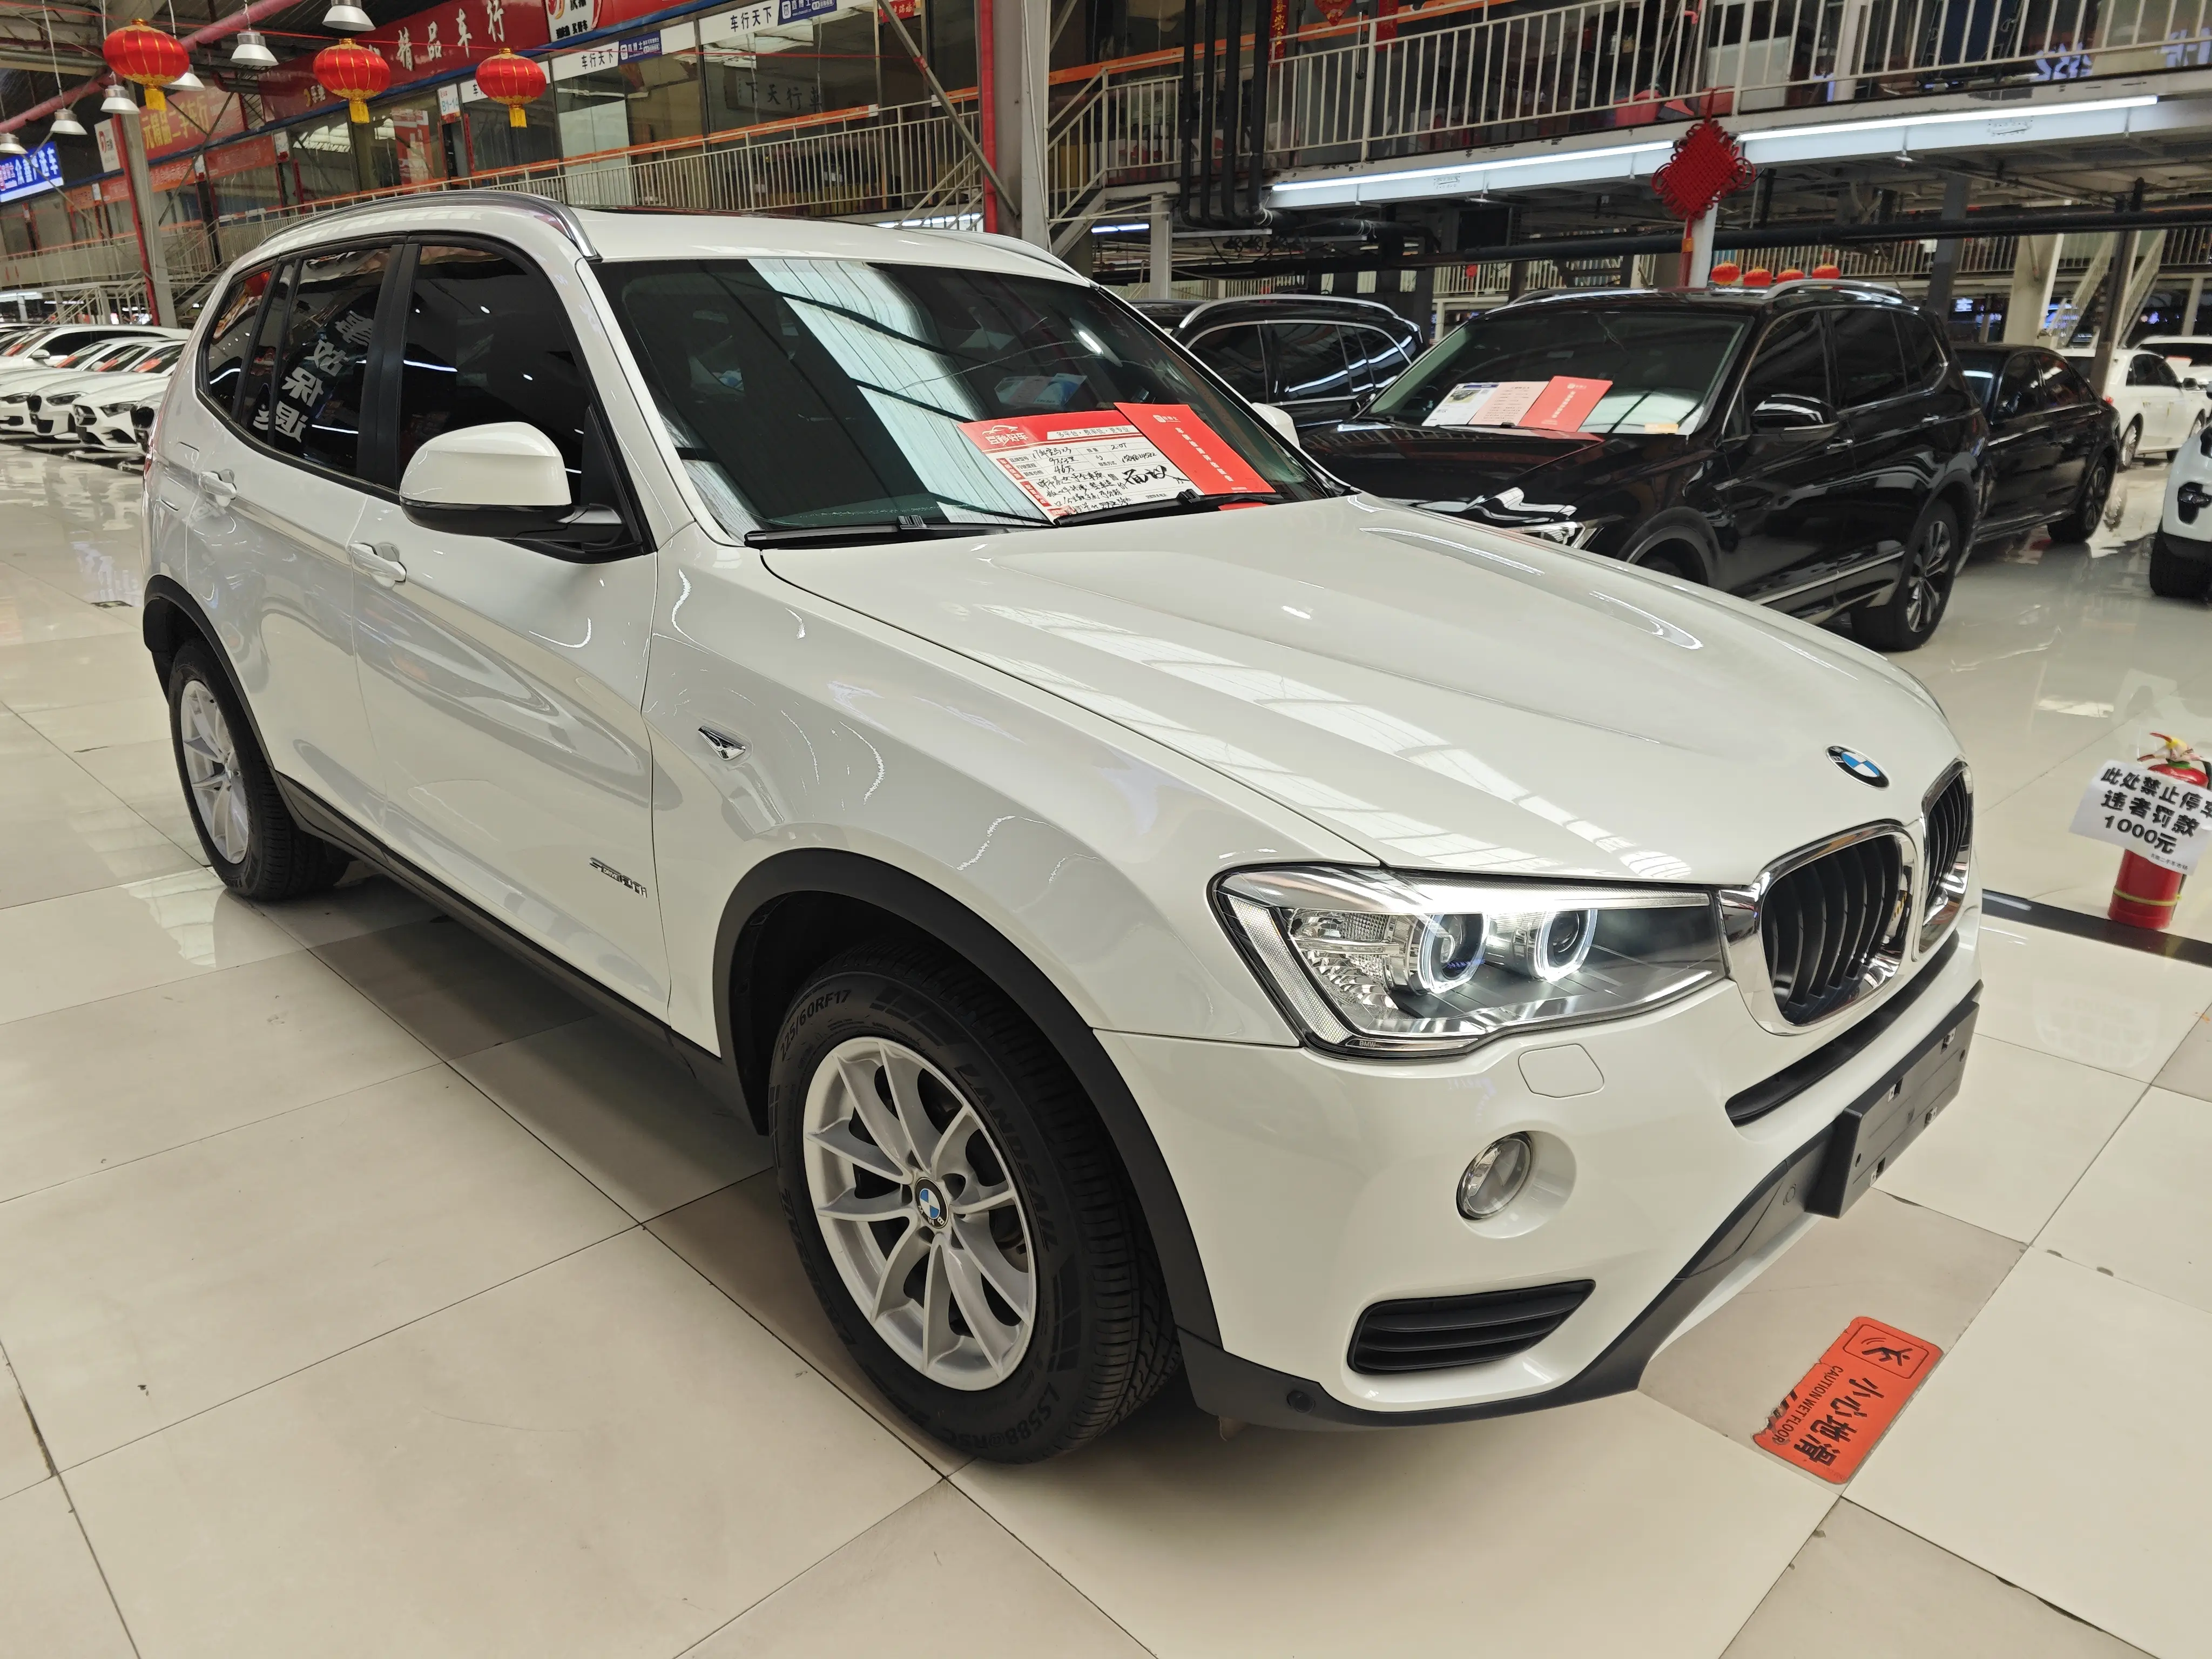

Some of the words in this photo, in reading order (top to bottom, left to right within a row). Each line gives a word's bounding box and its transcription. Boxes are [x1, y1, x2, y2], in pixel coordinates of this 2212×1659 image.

[369, 0, 505, 71] 精品车行
[730, 6, 772, 32] 车行天下
[581, 49, 613, 70] 车行天下
[2101, 790, 2201, 838] 违者罚款
[2105, 815, 2177, 854] 1000元
[1809, 1365, 1844, 1400] CAUTION
[1794, 1377, 1885, 1466] 小心地滑
[1795, 1398, 1817, 1418] WET
[1772, 1415, 1801, 1445] FLOOR
